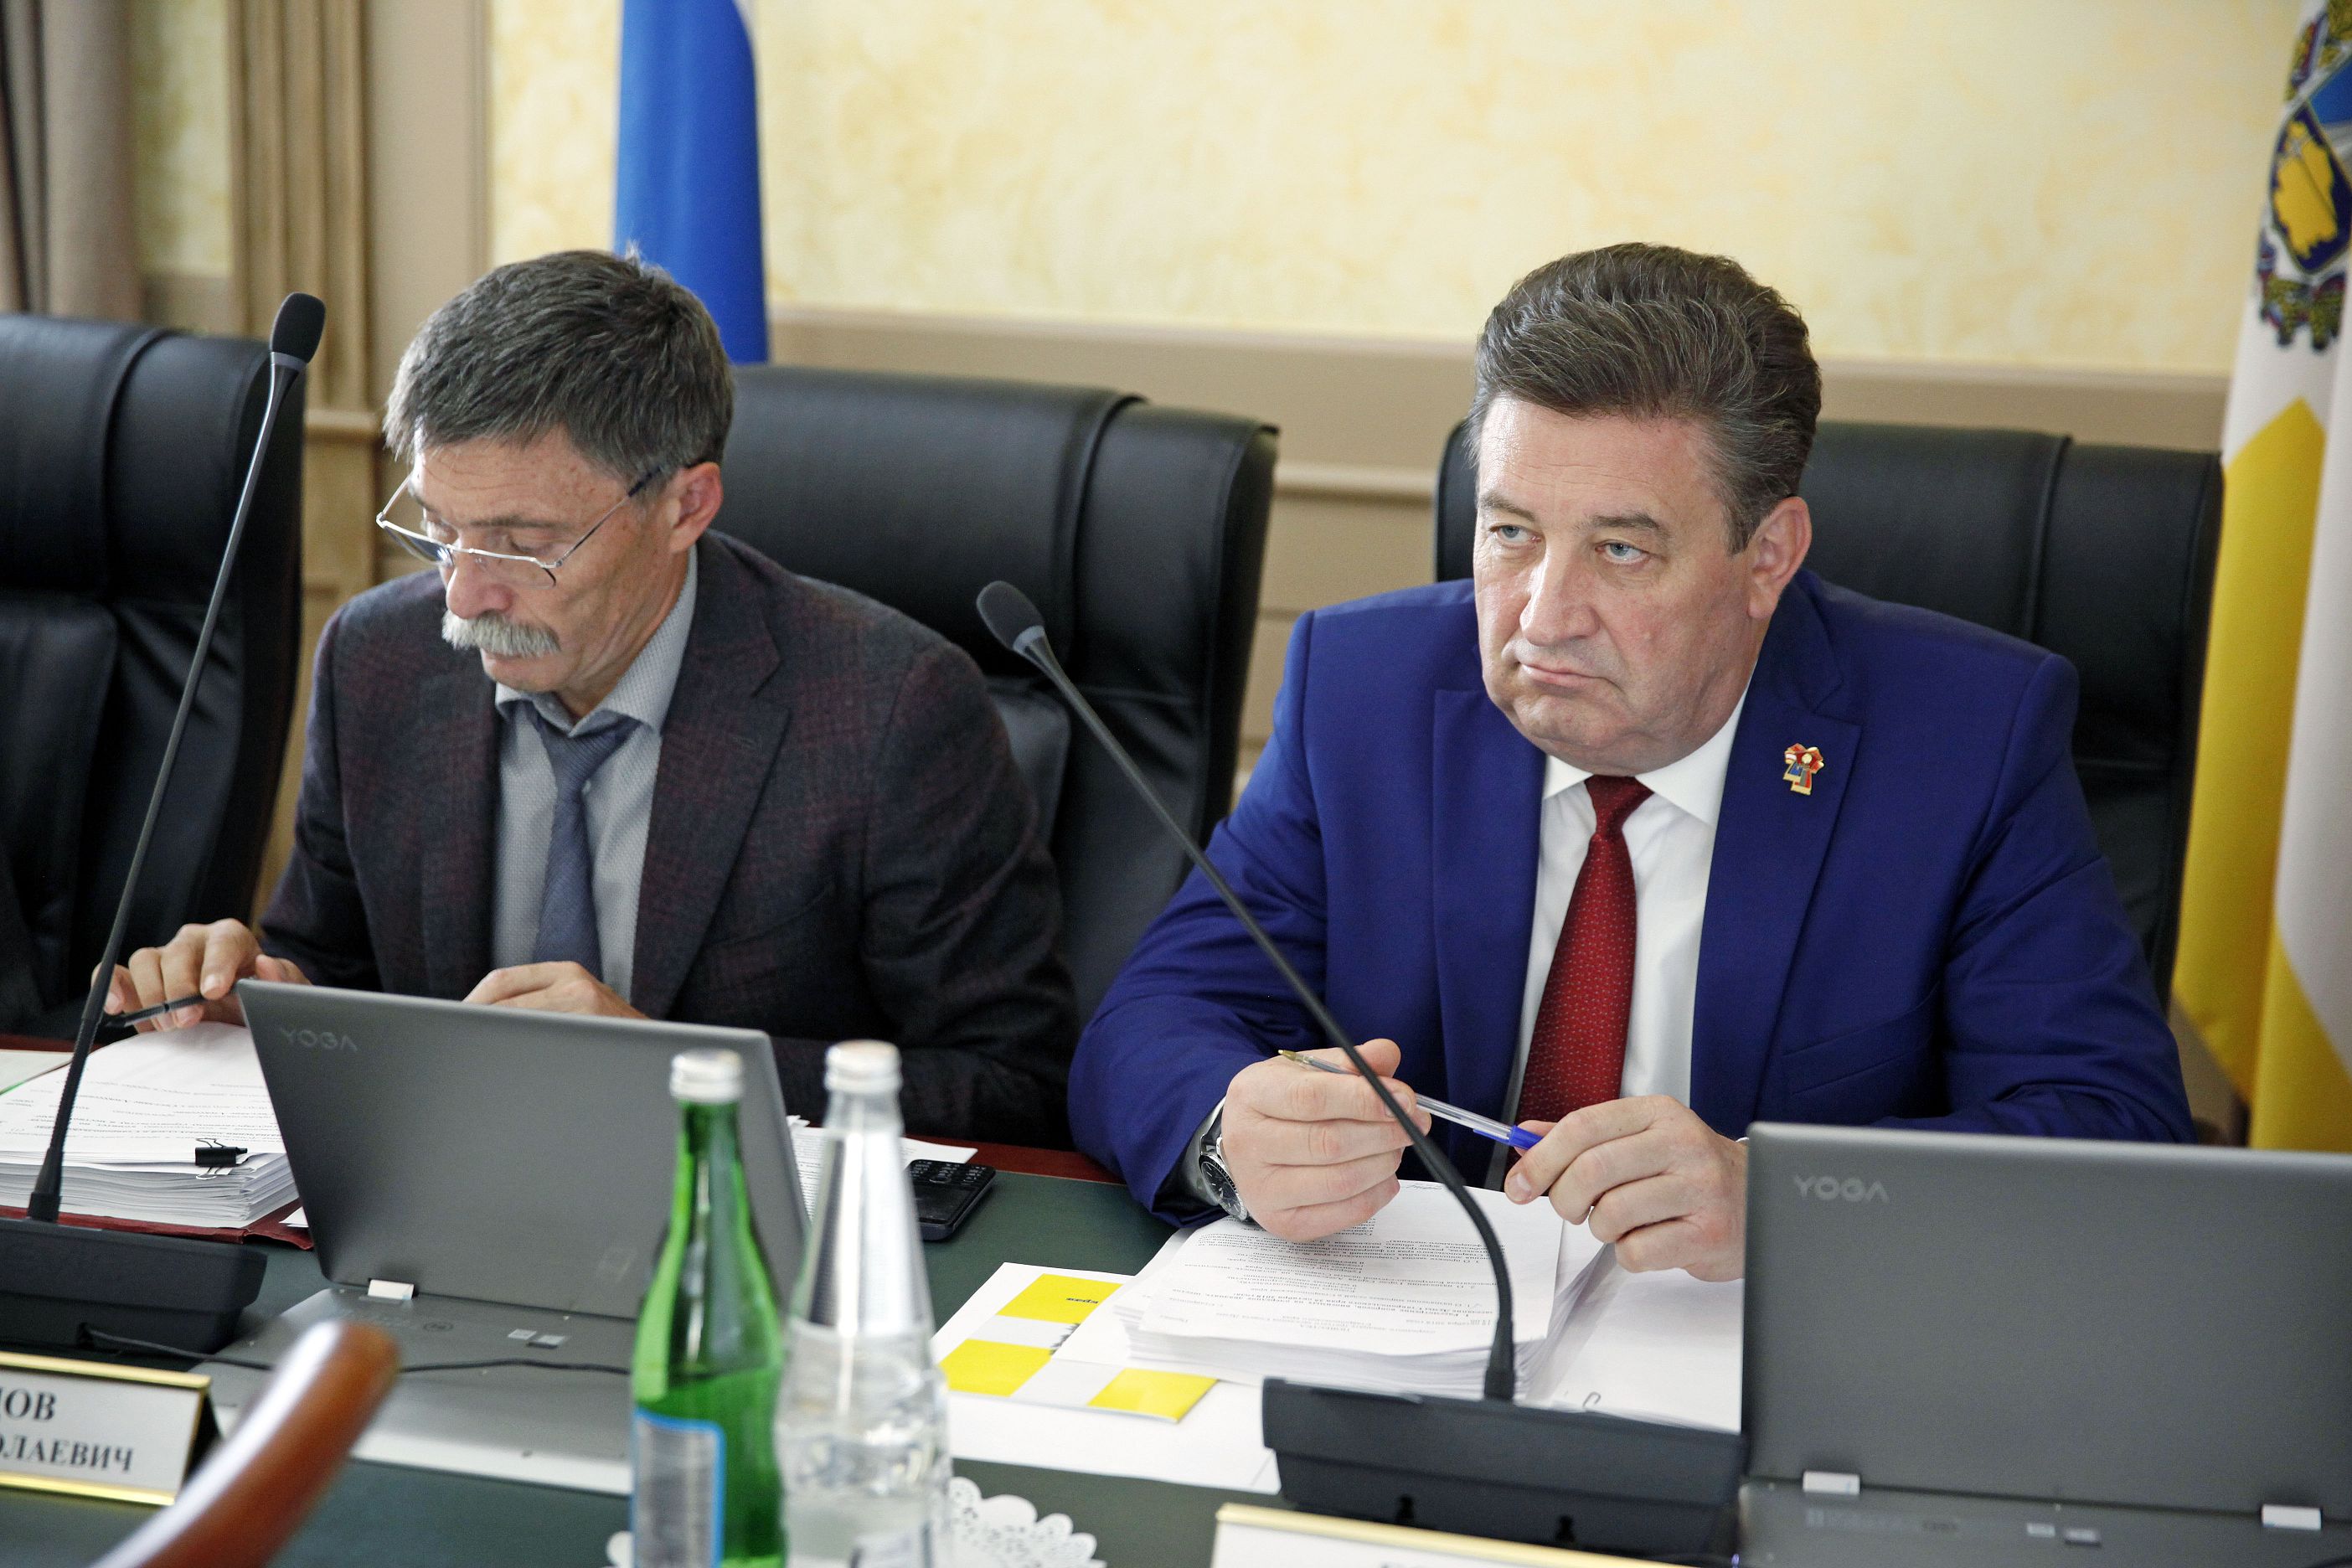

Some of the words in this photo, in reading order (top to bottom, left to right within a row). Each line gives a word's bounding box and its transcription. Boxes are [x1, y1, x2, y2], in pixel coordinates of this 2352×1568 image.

[279, 1028, 358, 1052] YOGA
[1793, 1173, 1891, 1203] YOGA
[0, 1387, 56, 1421] ОВ
[0, 1433, 133, 1472] ЛАЕВИЧ
